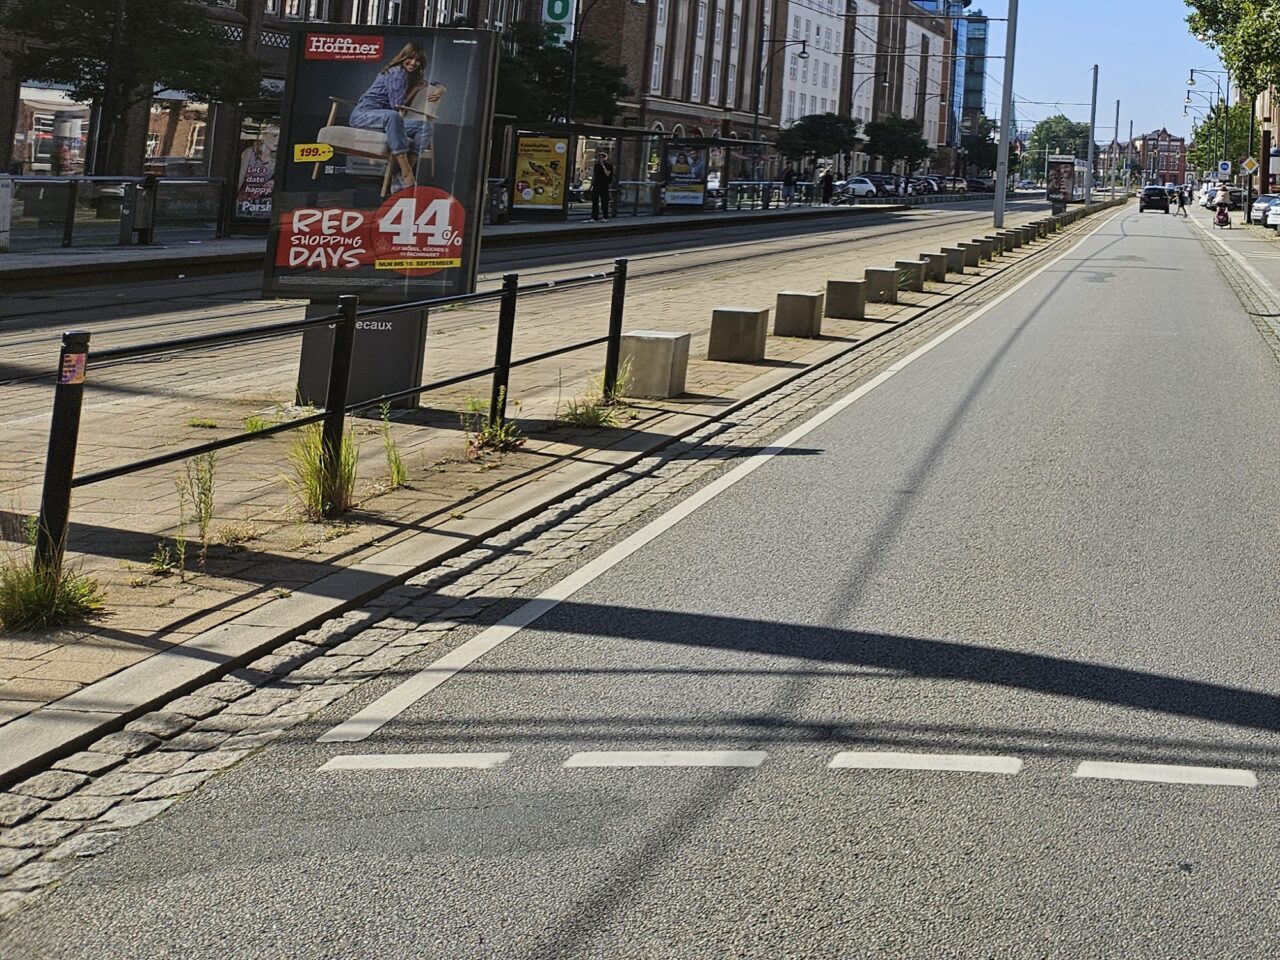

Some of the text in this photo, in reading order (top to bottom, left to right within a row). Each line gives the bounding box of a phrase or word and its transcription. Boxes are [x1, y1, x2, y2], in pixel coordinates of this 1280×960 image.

[308, 36, 380, 55] Höffner
[291, 208, 365, 236] RED
[289, 234, 363, 248] SHOPPING
[288, 246, 367, 269] DAYS
